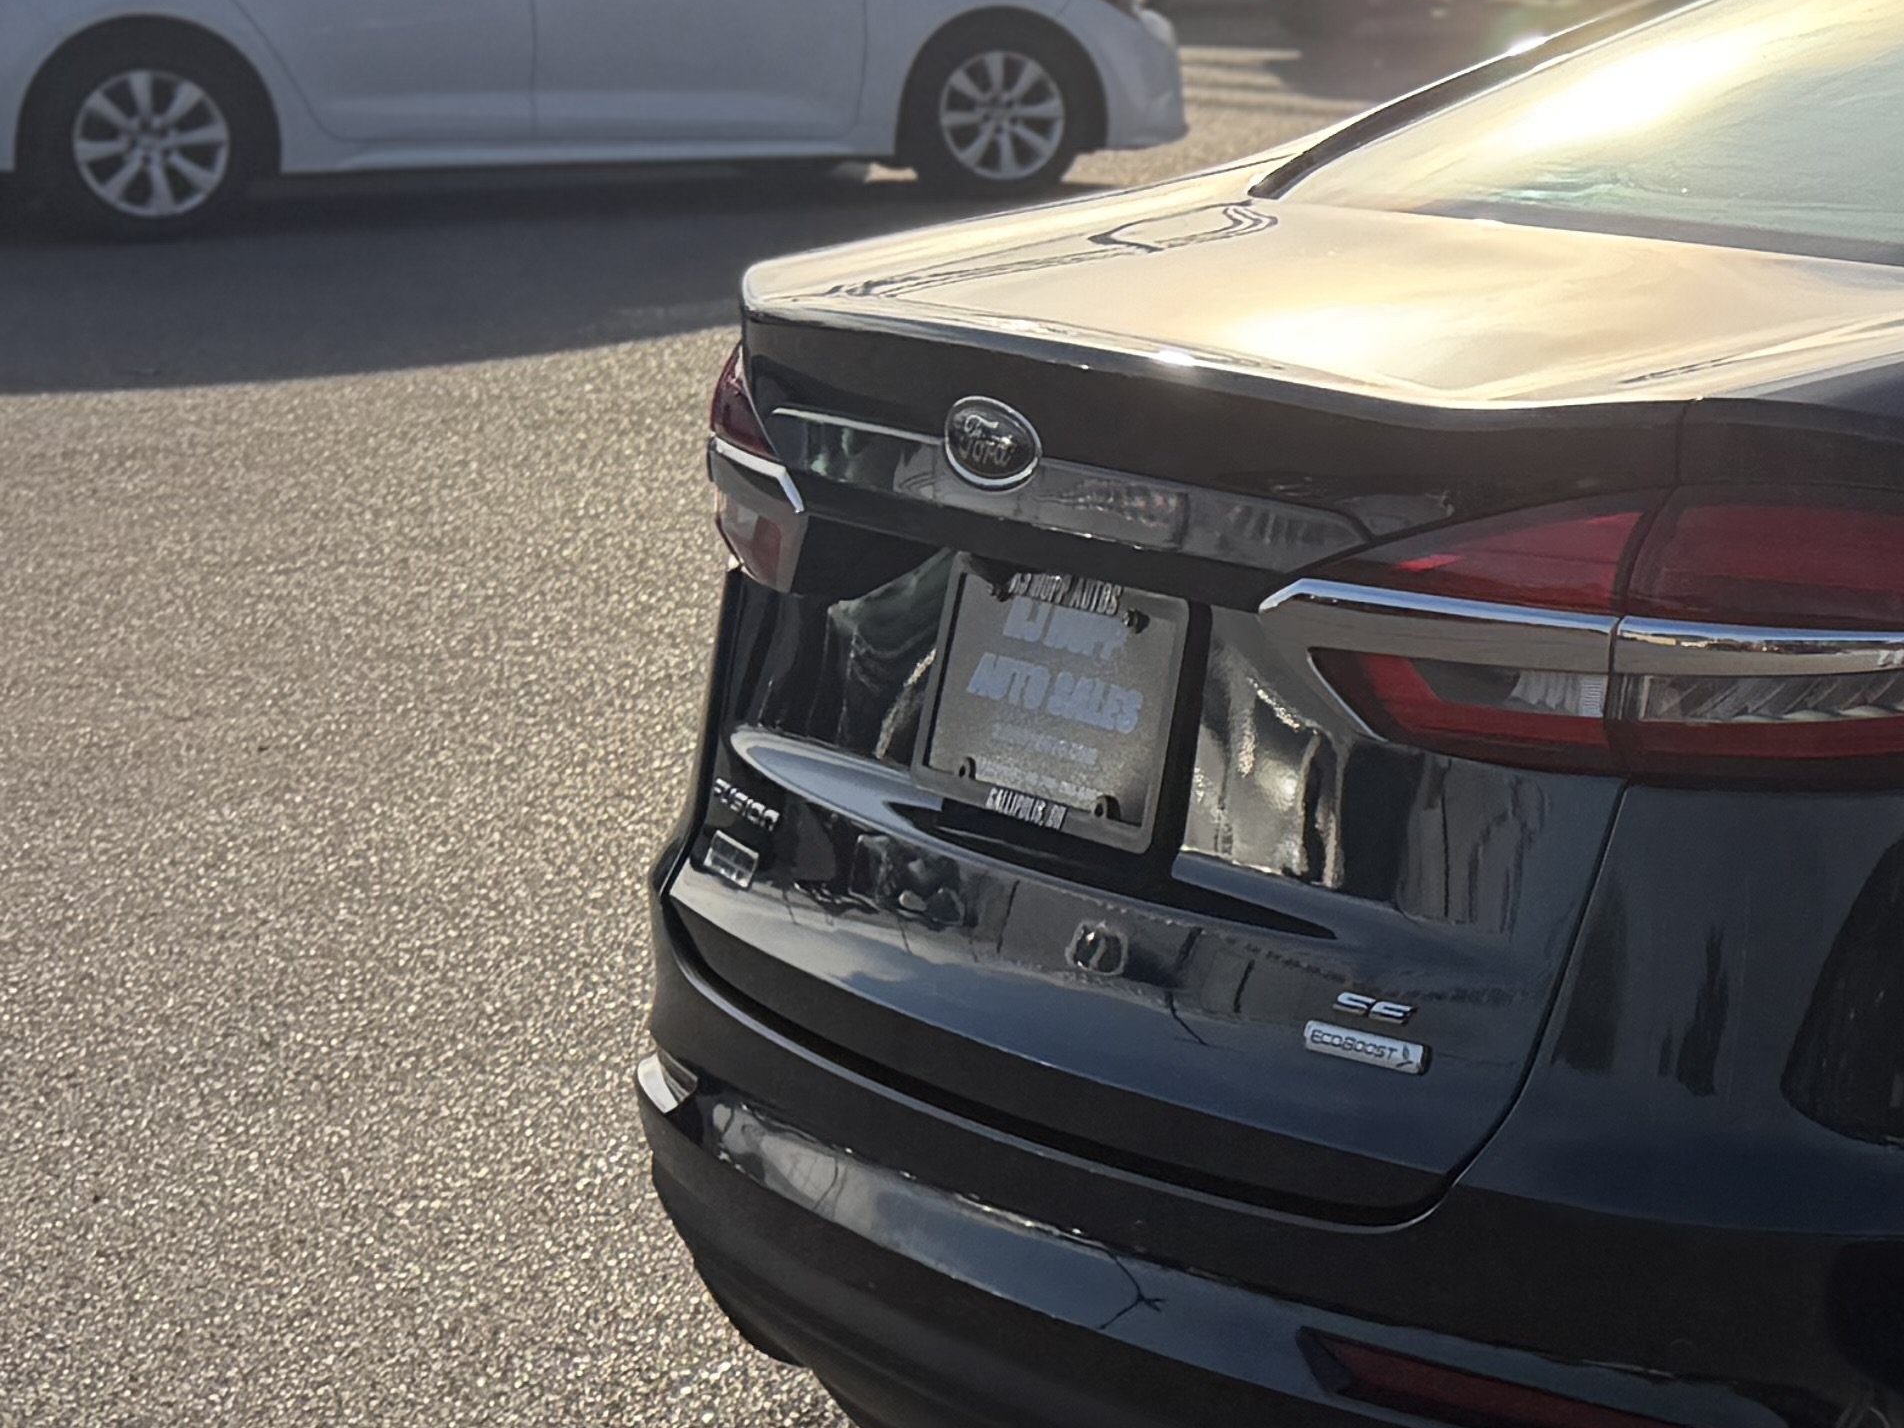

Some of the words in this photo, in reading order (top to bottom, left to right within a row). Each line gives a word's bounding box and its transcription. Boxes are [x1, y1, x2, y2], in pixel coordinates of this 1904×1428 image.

[955, 413, 1017, 468] Ford
[1070, 577, 1122, 615] AUTOS
[966, 652, 1051, 710] AUTO
[1050, 672, 1143, 734] SALES
[713, 777, 780, 832] FUSION
[1332, 991, 1414, 1024] SE
